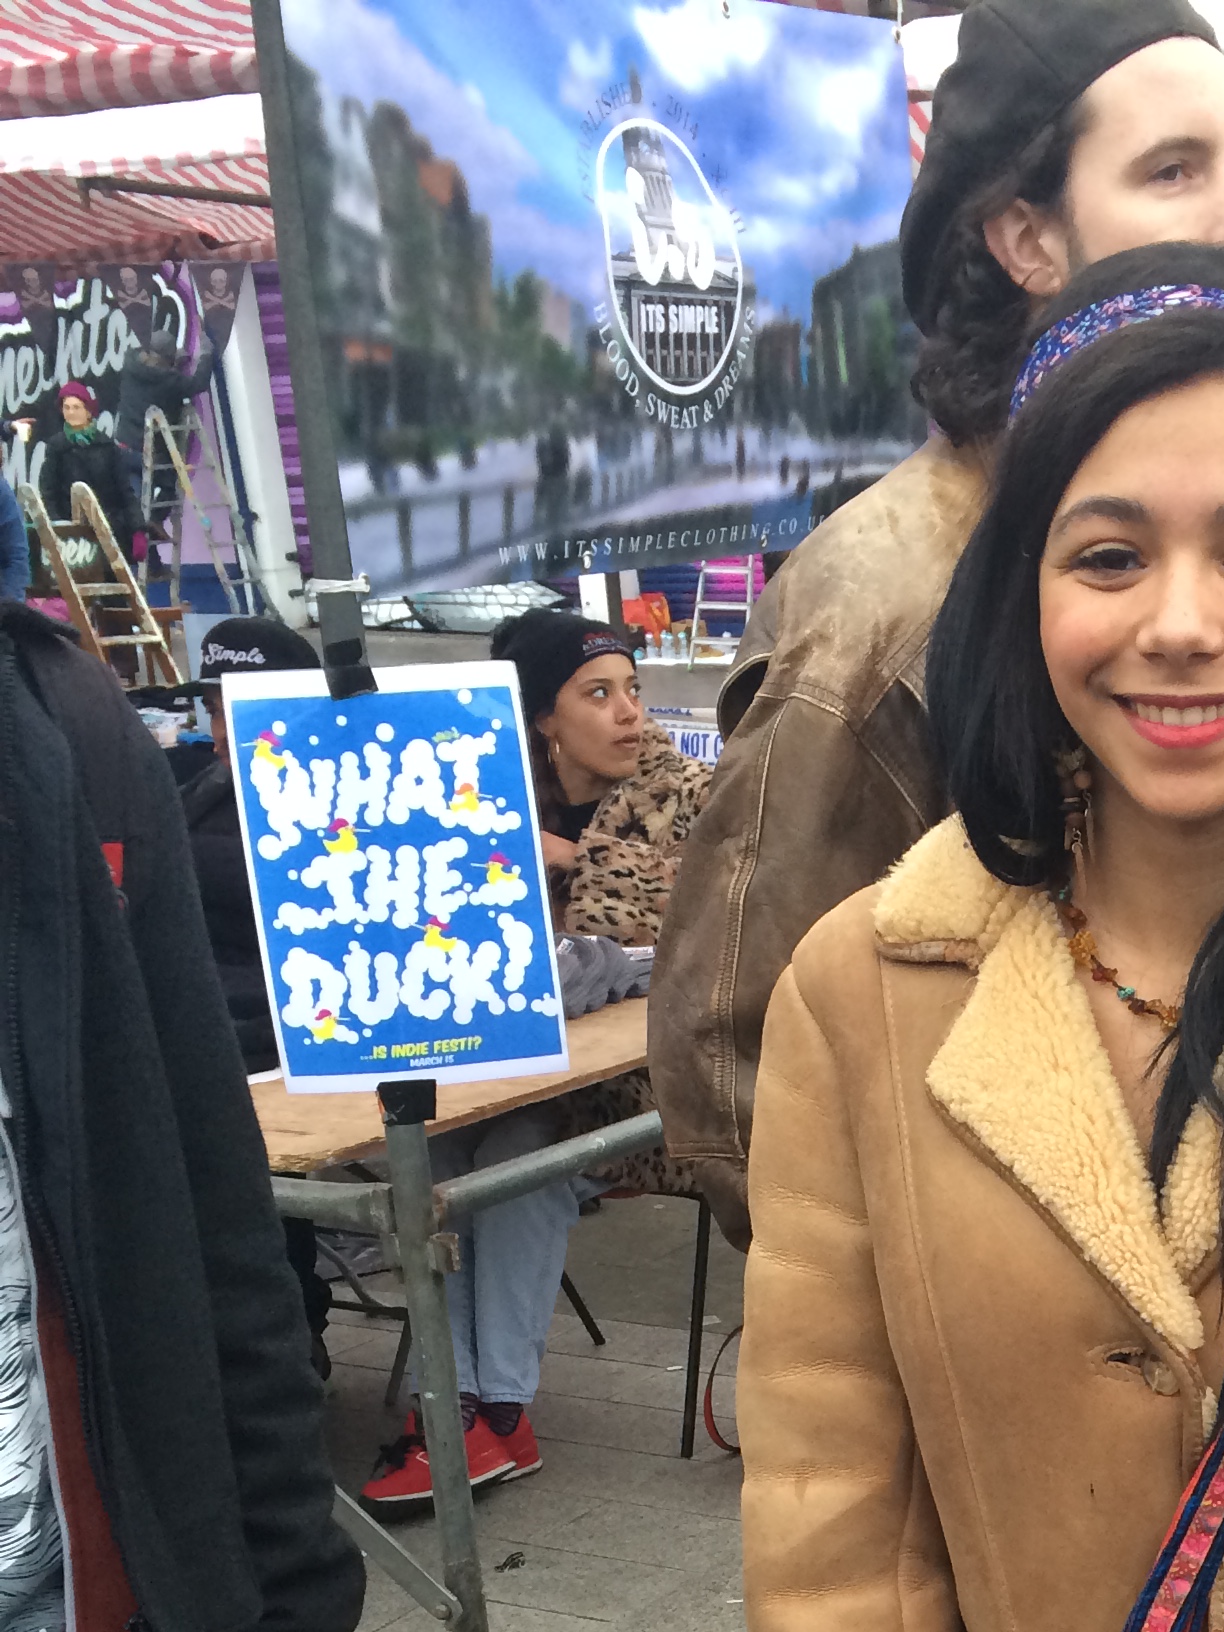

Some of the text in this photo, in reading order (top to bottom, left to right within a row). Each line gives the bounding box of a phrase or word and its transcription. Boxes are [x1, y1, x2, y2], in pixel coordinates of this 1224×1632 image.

[640, 303, 720, 335] ITS SIMPLE
[645, 392, 700, 429] SWEAT
[703, 399, 714, 423] &
[204, 643, 266, 665] Simple
[680, 731, 710, 758] NOT
[250, 732, 522, 860] WHAT
[273, 837, 527, 936] THE
[281, 912, 534, 1042] DUCK!
[391, 1041, 429, 1058] INDIE
[409, 1056, 442, 1067] MARCH
